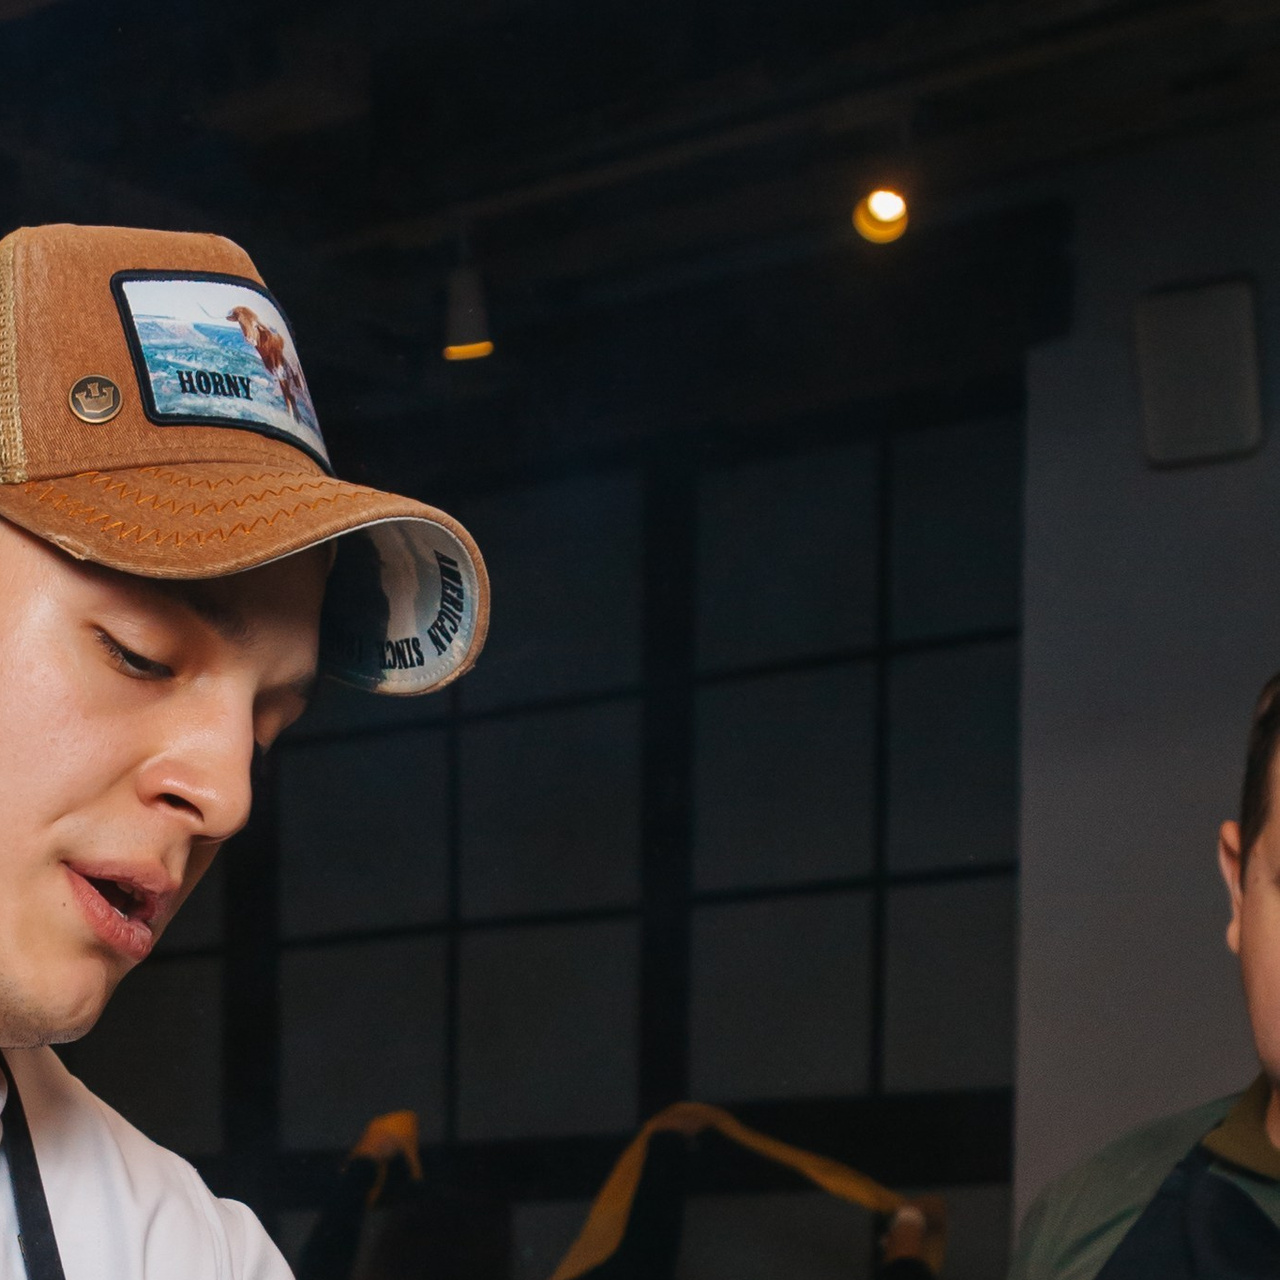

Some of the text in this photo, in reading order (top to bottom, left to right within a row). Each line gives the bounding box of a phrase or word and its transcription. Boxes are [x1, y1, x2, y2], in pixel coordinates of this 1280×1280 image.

[176, 370, 254, 402] HORNY
[378, 549, 465, 670] AMERICAN SINCE
